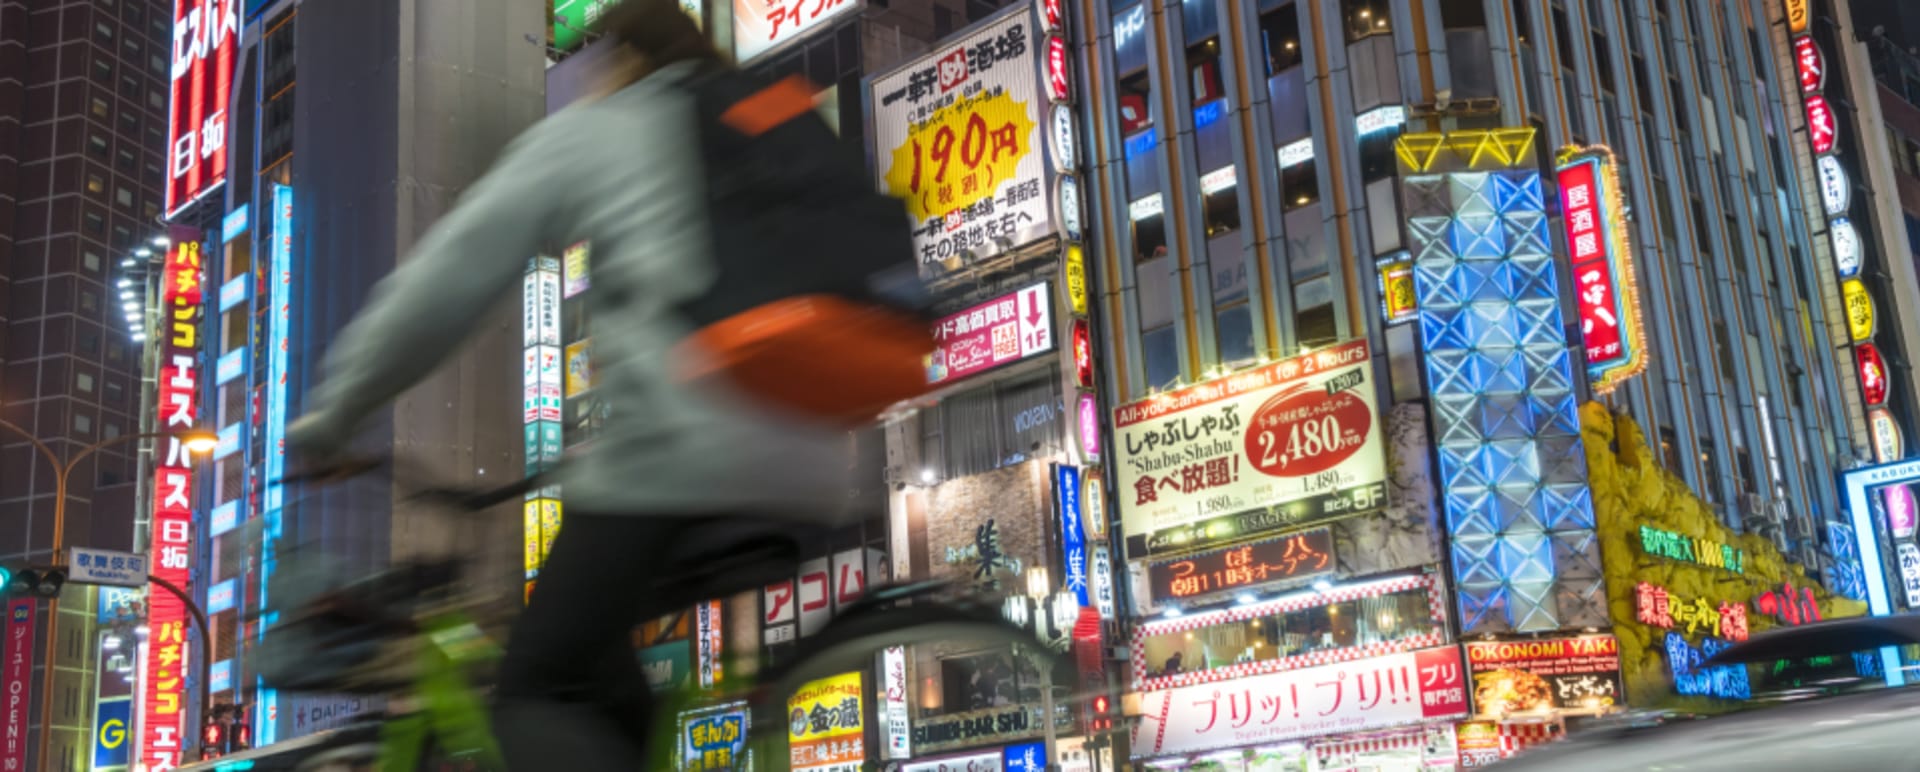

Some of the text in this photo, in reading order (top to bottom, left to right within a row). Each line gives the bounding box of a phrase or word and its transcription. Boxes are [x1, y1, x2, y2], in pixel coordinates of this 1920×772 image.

[174, 109, 225, 179] 日拓
[909, 111, 1019, 195] 190円
[1567, 184, 1598, 258] 居酒屋
[172, 241, 200, 349] パチンコ
[1580, 270, 1617, 334] つぼ八
[1025, 328, 1047, 351] 1F
[1303, 357, 1316, 374] 2
[1125, 403, 1240, 456] しゃぶしゃぶ
[1257, 414, 1340, 469] 2,480
[1353, 484, 1384, 511] 5F
[1870, 464, 1920, 480] KABUK
[77, 553, 143, 571] 歌舞伎町
[1170, 553, 1329, 597] 朝11時オープン
[766, 562, 864, 622] アコム
[155, 621, 182, 714] パチンコ
[1470, 637, 1617, 661] OKONOMI YAKI
[1422, 687, 1463, 706] 専門店
